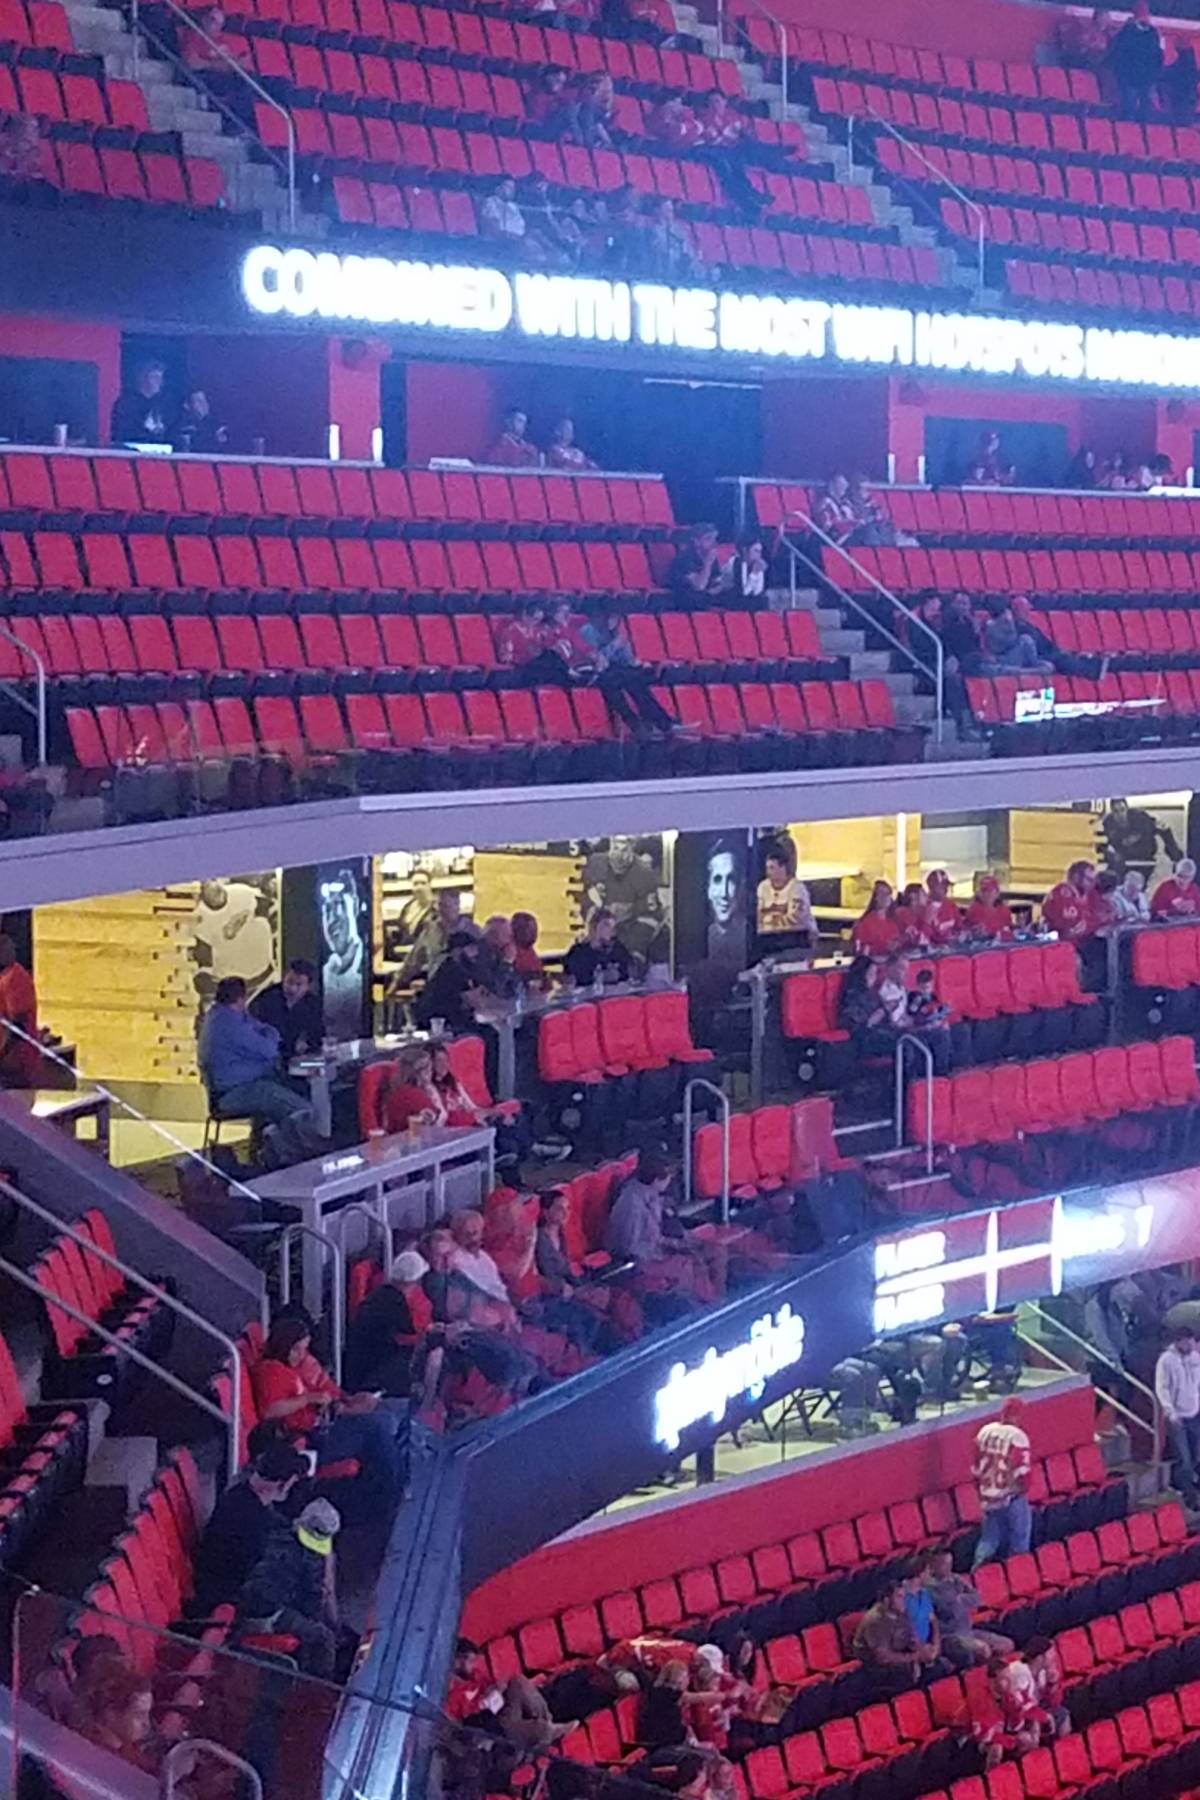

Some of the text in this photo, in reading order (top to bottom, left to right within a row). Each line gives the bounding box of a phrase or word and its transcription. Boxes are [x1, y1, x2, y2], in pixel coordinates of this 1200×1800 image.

[515, 273, 630, 341] WITH
[632, 284, 716, 349] THE
[719, 292, 831, 358] MOST
